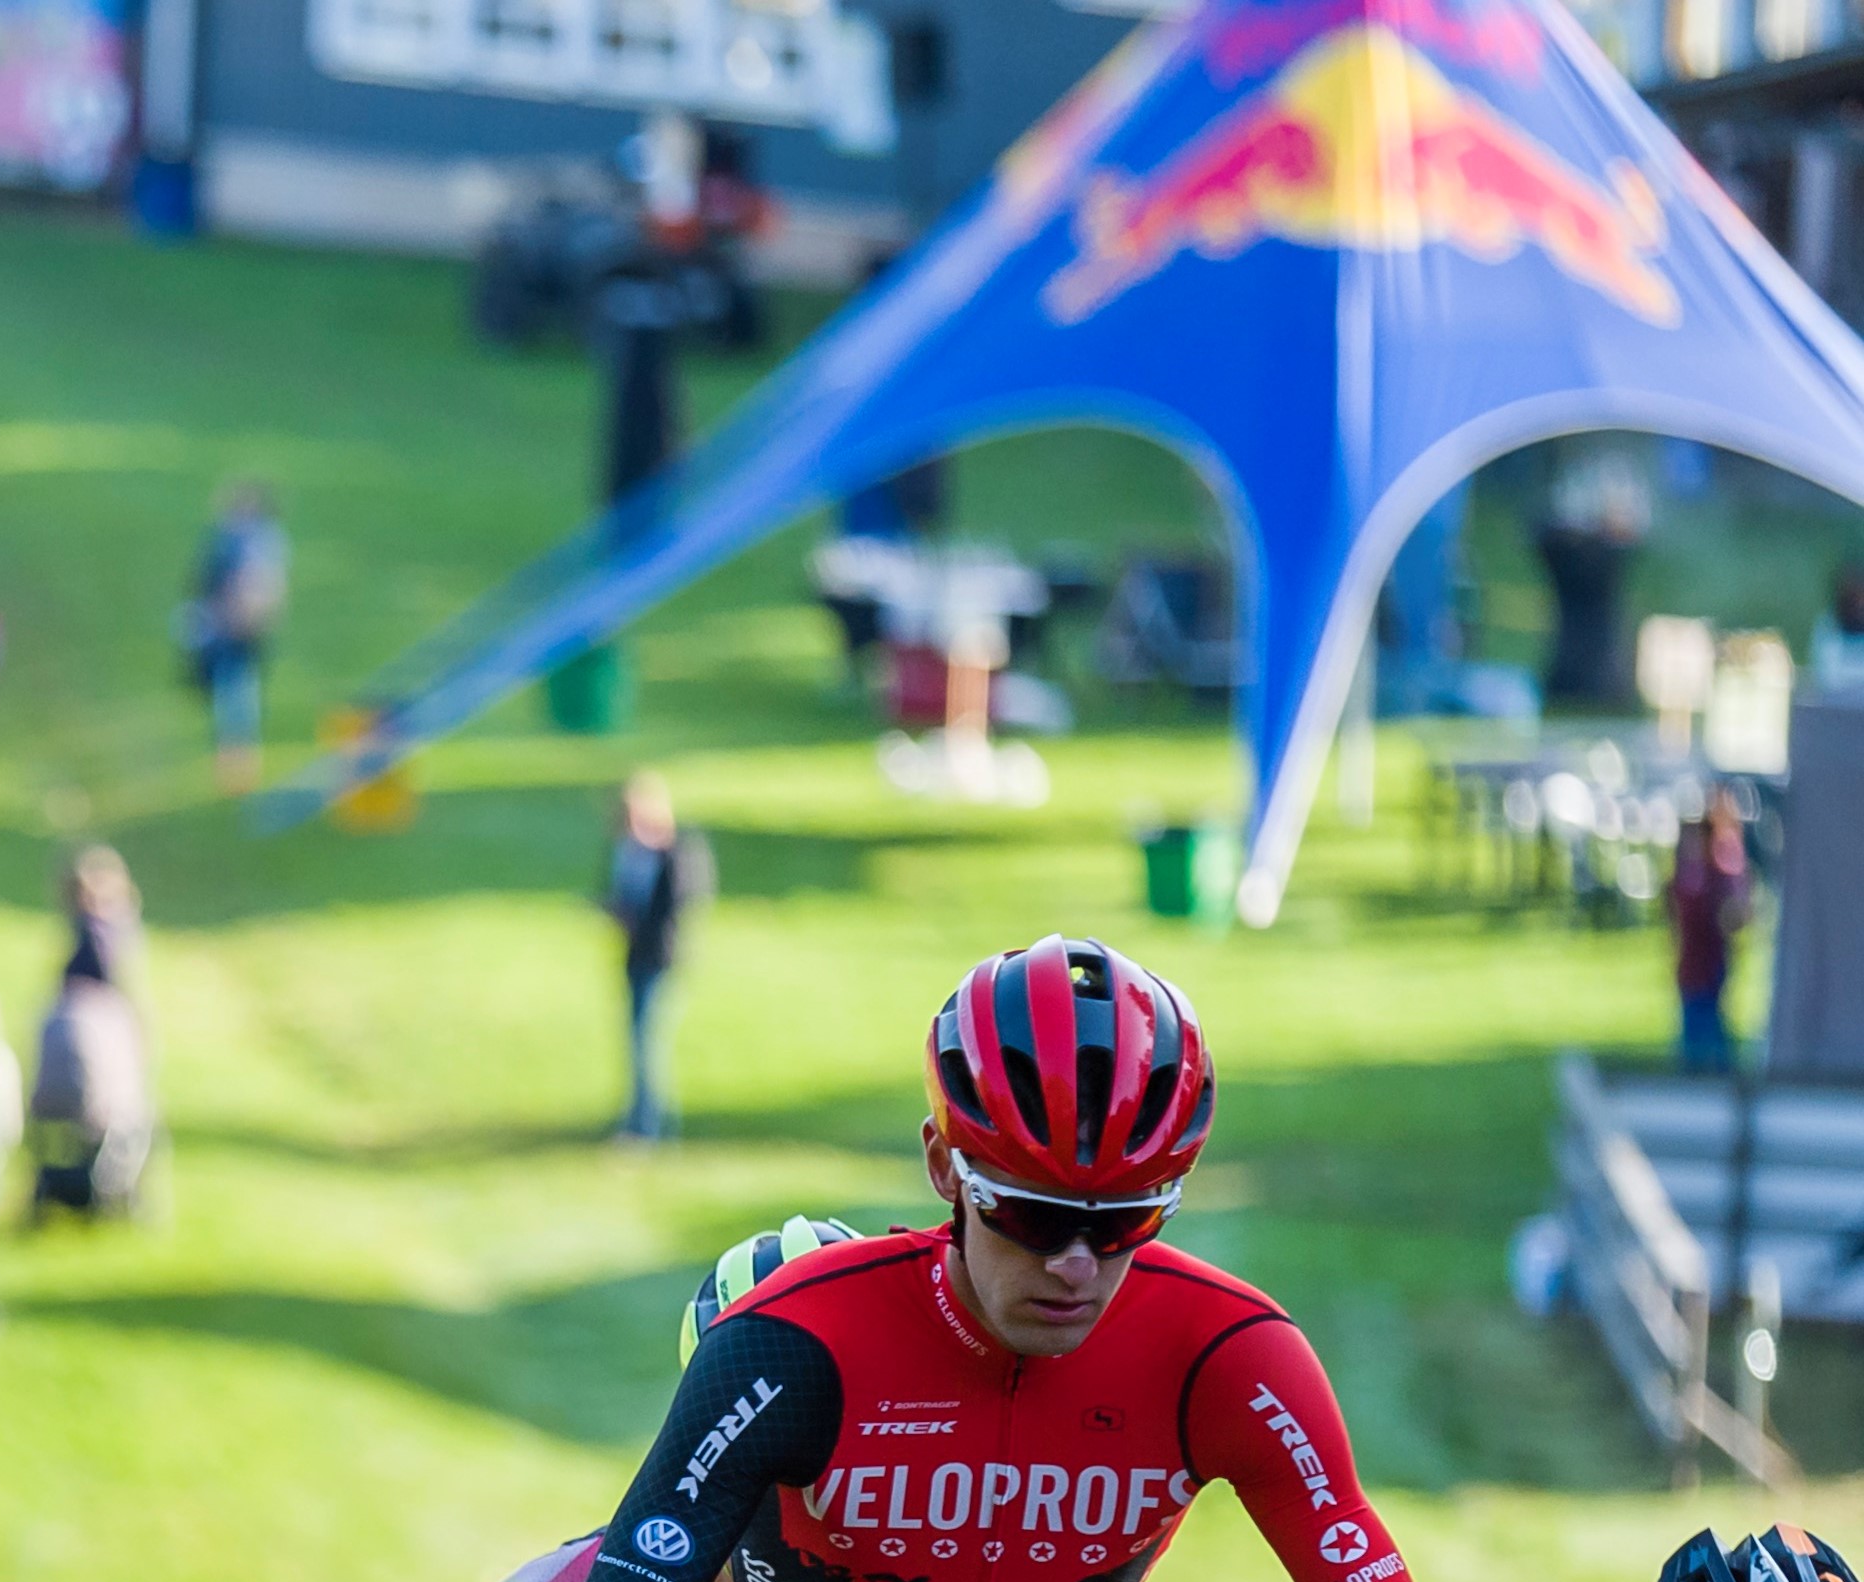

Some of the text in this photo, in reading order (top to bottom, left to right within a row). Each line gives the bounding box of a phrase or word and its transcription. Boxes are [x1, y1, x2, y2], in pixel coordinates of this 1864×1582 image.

[935, 1286, 990, 1357] VELOPROFS
[676, 1376, 783, 1503] TREK
[858, 1420, 959, 1436] TREK
[1248, 1382, 1338, 1511] TREK
